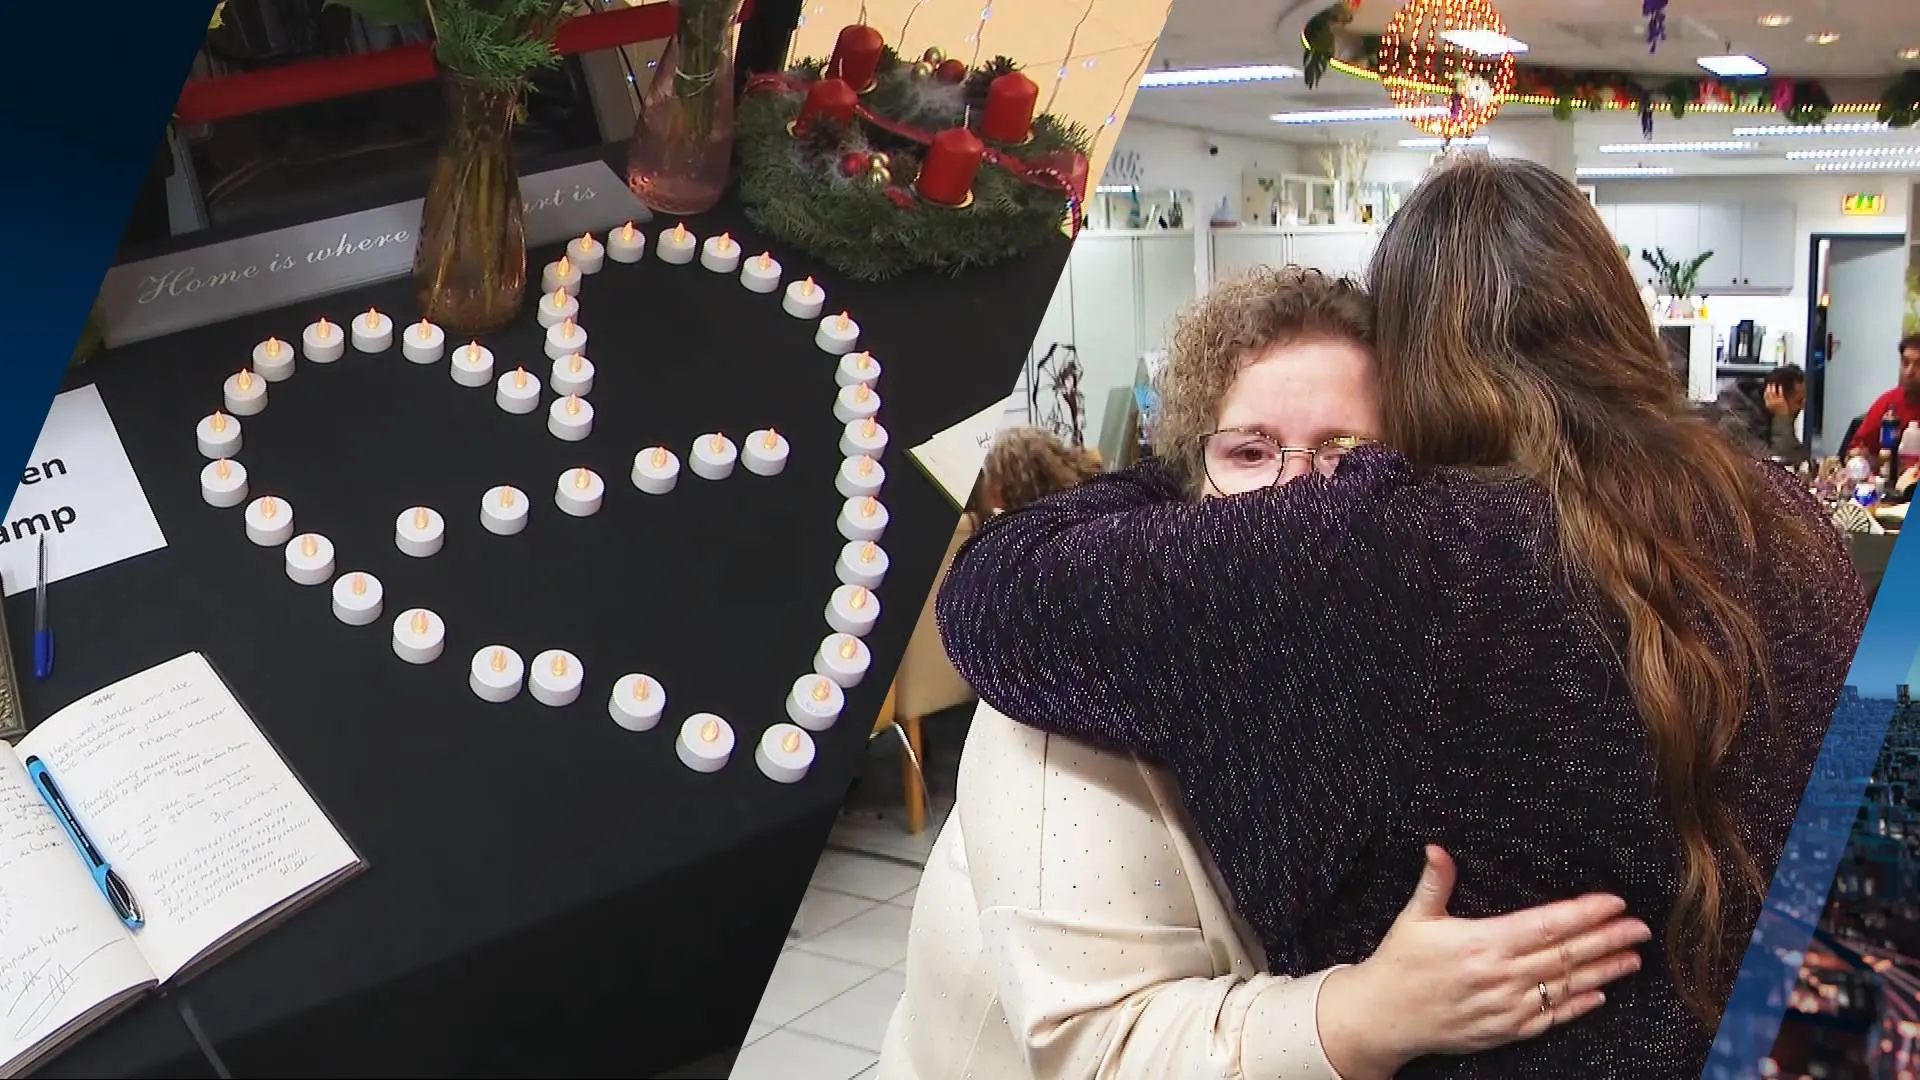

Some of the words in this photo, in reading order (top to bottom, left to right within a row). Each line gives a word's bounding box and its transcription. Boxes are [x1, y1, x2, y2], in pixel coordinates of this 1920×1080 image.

[138, 266, 259, 303] Home
[269, 253, 297, 272] is
[305, 232, 410, 264] where
[572, 185, 597, 201] is
[20, 458, 67, 485] en
